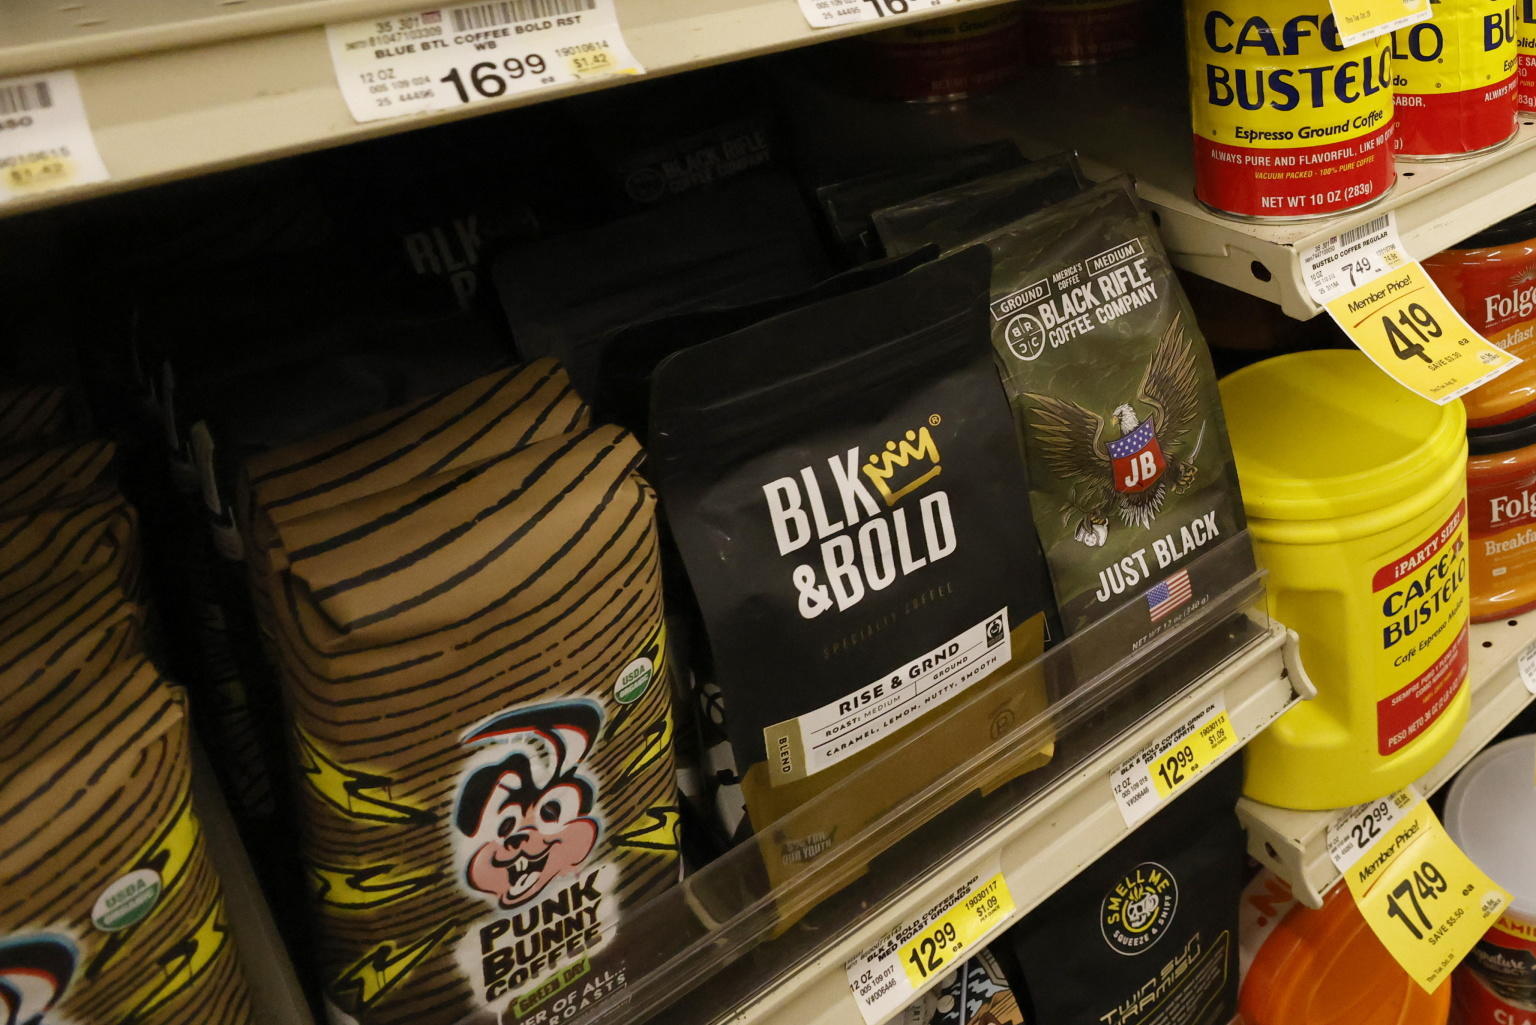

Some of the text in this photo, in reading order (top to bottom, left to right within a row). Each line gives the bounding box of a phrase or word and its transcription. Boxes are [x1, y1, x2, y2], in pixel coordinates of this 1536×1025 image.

[374, 15, 582, 60] BLUE BTL COFFEE BOLD RST
[474, 40, 497, 52] WB
[572, 54, 608, 68] $1.42
[1206, 45, 1393, 112] BUSTELO
[1235, 110, 1383, 144] Espresso Ground Coffee
[1261, 179, 1373, 208] NET WT 10 OZ (283g)
[1000, 245, 1135, 314] GROUND MEDIUM
[1312, 231, 1388, 270] BUSTELO COFFEE REGULAR
[1038, 260, 1152, 330] BLACK RIFLE
[1049, 282, 1158, 349] COFFEE COMPANY
[1347, 274, 1412, 314] Member Price!
[762, 446, 881, 556] BLK
[1124, 451, 1157, 487] JB
[1095, 510, 1220, 603] JUST BLACK
[1382, 557, 1466, 650] BUSTELO
[826, 656, 968, 737] ROAST: MEDIUM GROUND
[839, 642, 960, 716] RISE & GRND
[1359, 820, 1420, 883] Member Price!
[479, 869, 602, 956] PUNK
[878, 888, 972, 962] MED ROAST GROUNDS
[1108, 869, 1170, 925] SMELL ME
[1428, 884, 1474, 945] SAVE $5.50 ea
[482, 899, 602, 987] BUNNY
[486, 922, 601, 1003] COFFEE
